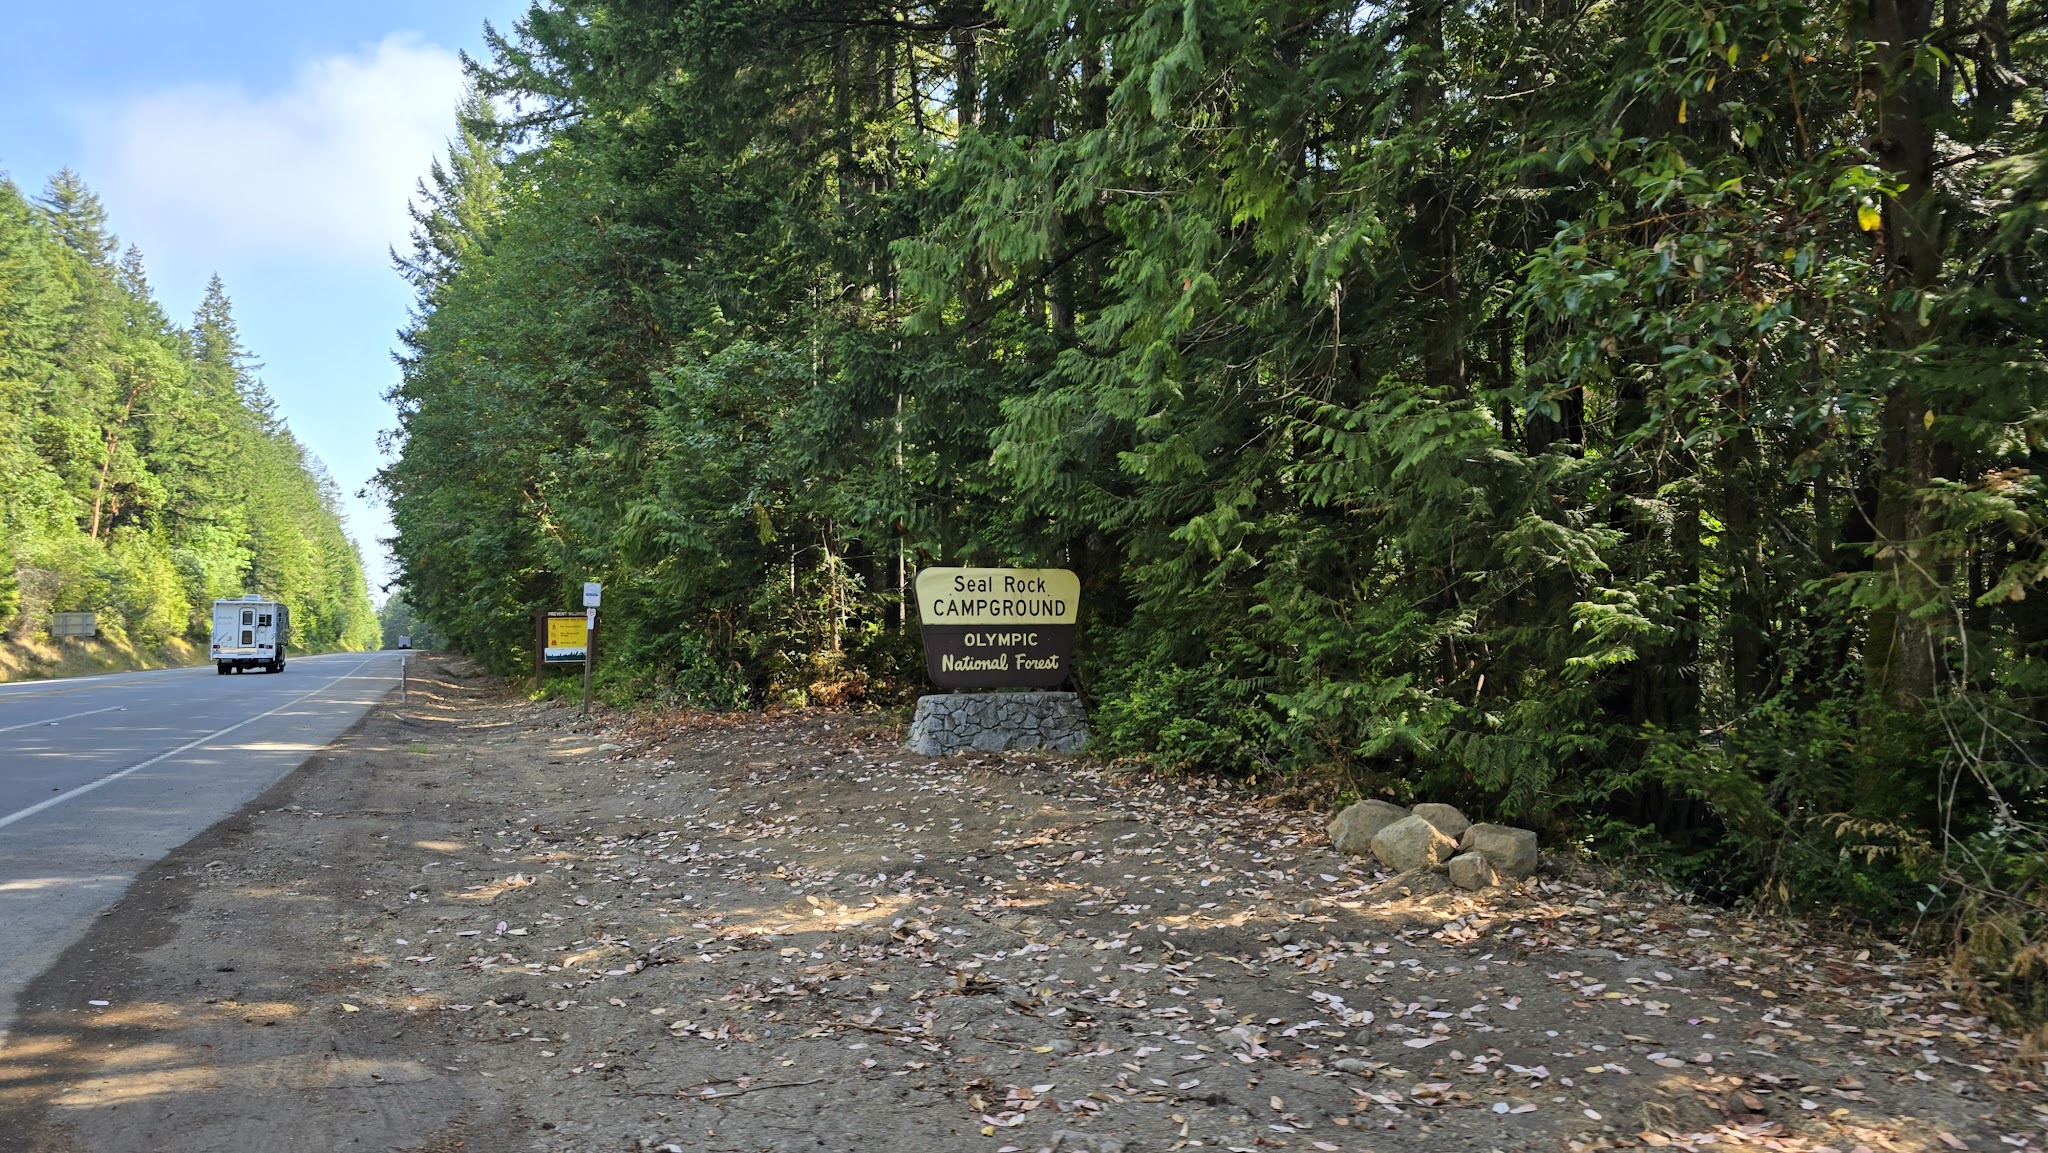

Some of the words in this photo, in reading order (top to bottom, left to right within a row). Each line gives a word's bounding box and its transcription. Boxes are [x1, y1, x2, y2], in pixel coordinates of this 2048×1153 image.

[954, 575, 992, 592] Seal
[1005, 575, 1046, 593] Rock
[933, 599, 1066, 616] CAMPGROUND
[964, 633, 1038, 646] OLYMPIC
[942, 653, 1009, 672] National
[1015, 653, 1060, 670] Forest
